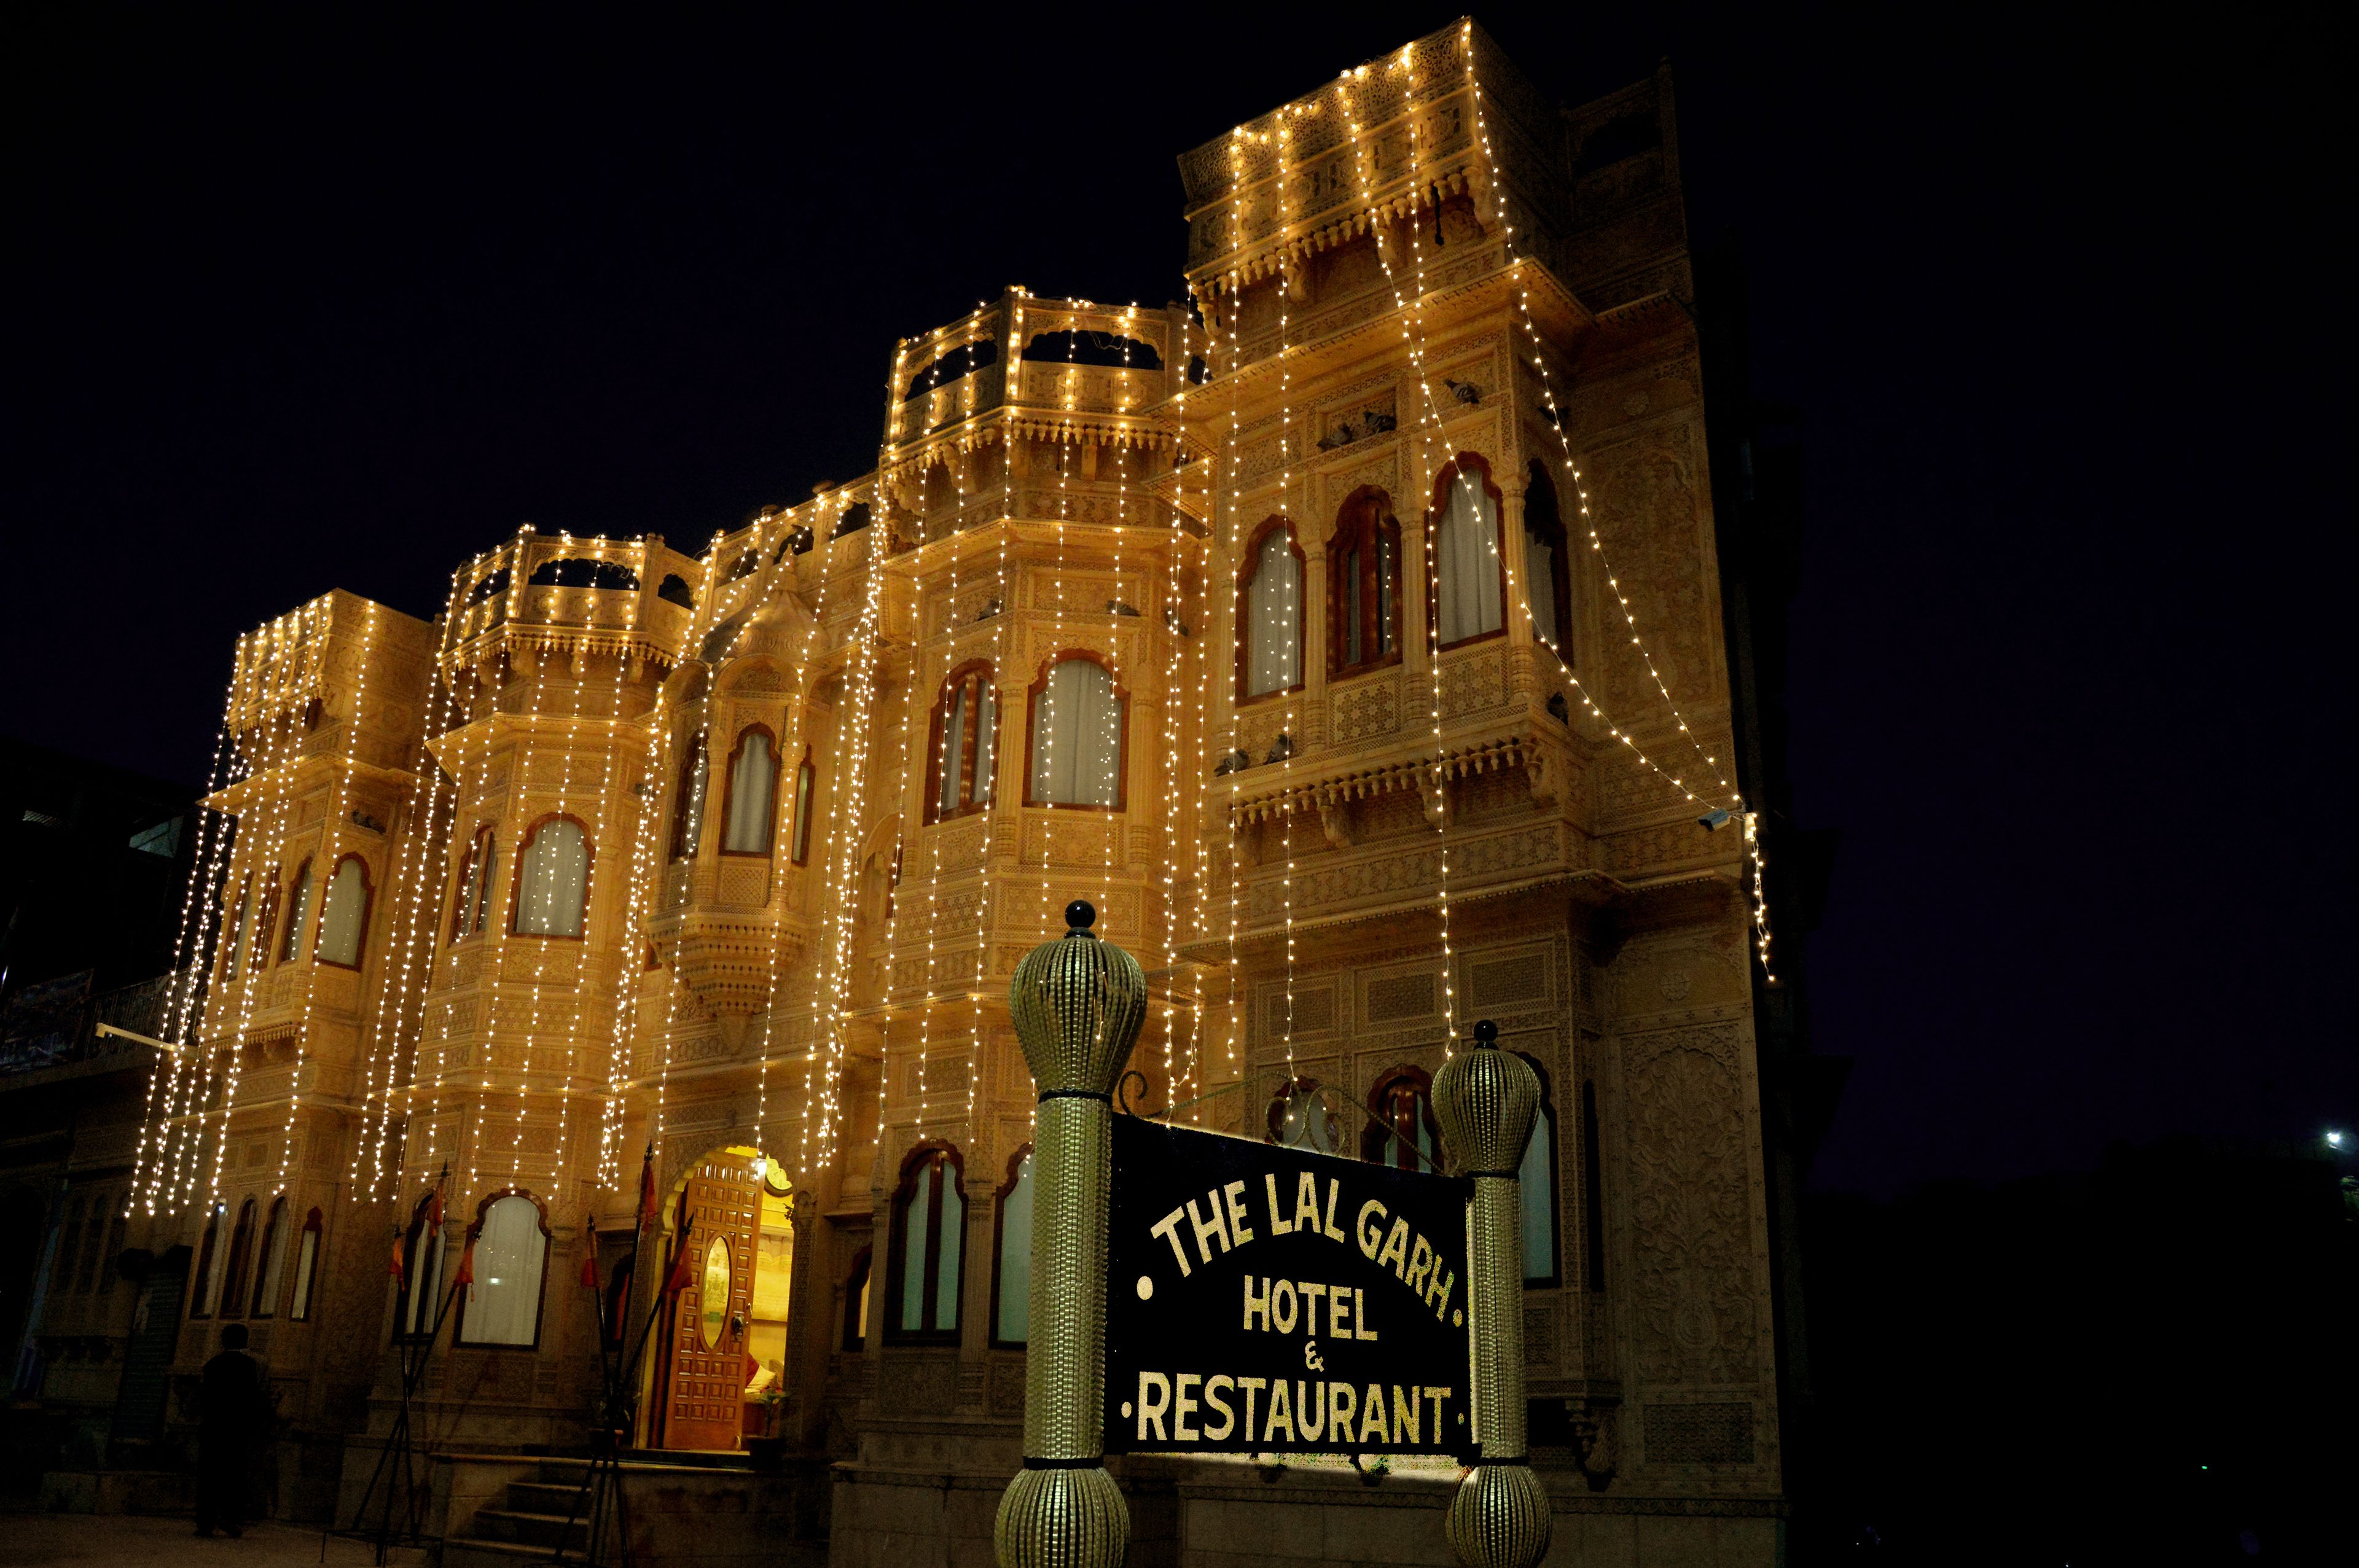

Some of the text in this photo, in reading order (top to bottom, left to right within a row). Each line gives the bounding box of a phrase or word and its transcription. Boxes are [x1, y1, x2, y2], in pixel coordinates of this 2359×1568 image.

[1150, 1171, 1455, 1322] THE LAL GARH
[1243, 1274, 1378, 1341] HOTEL
[1305, 1341, 1324, 1372] &
[1137, 1371, 1452, 1445] RESTAURANT
